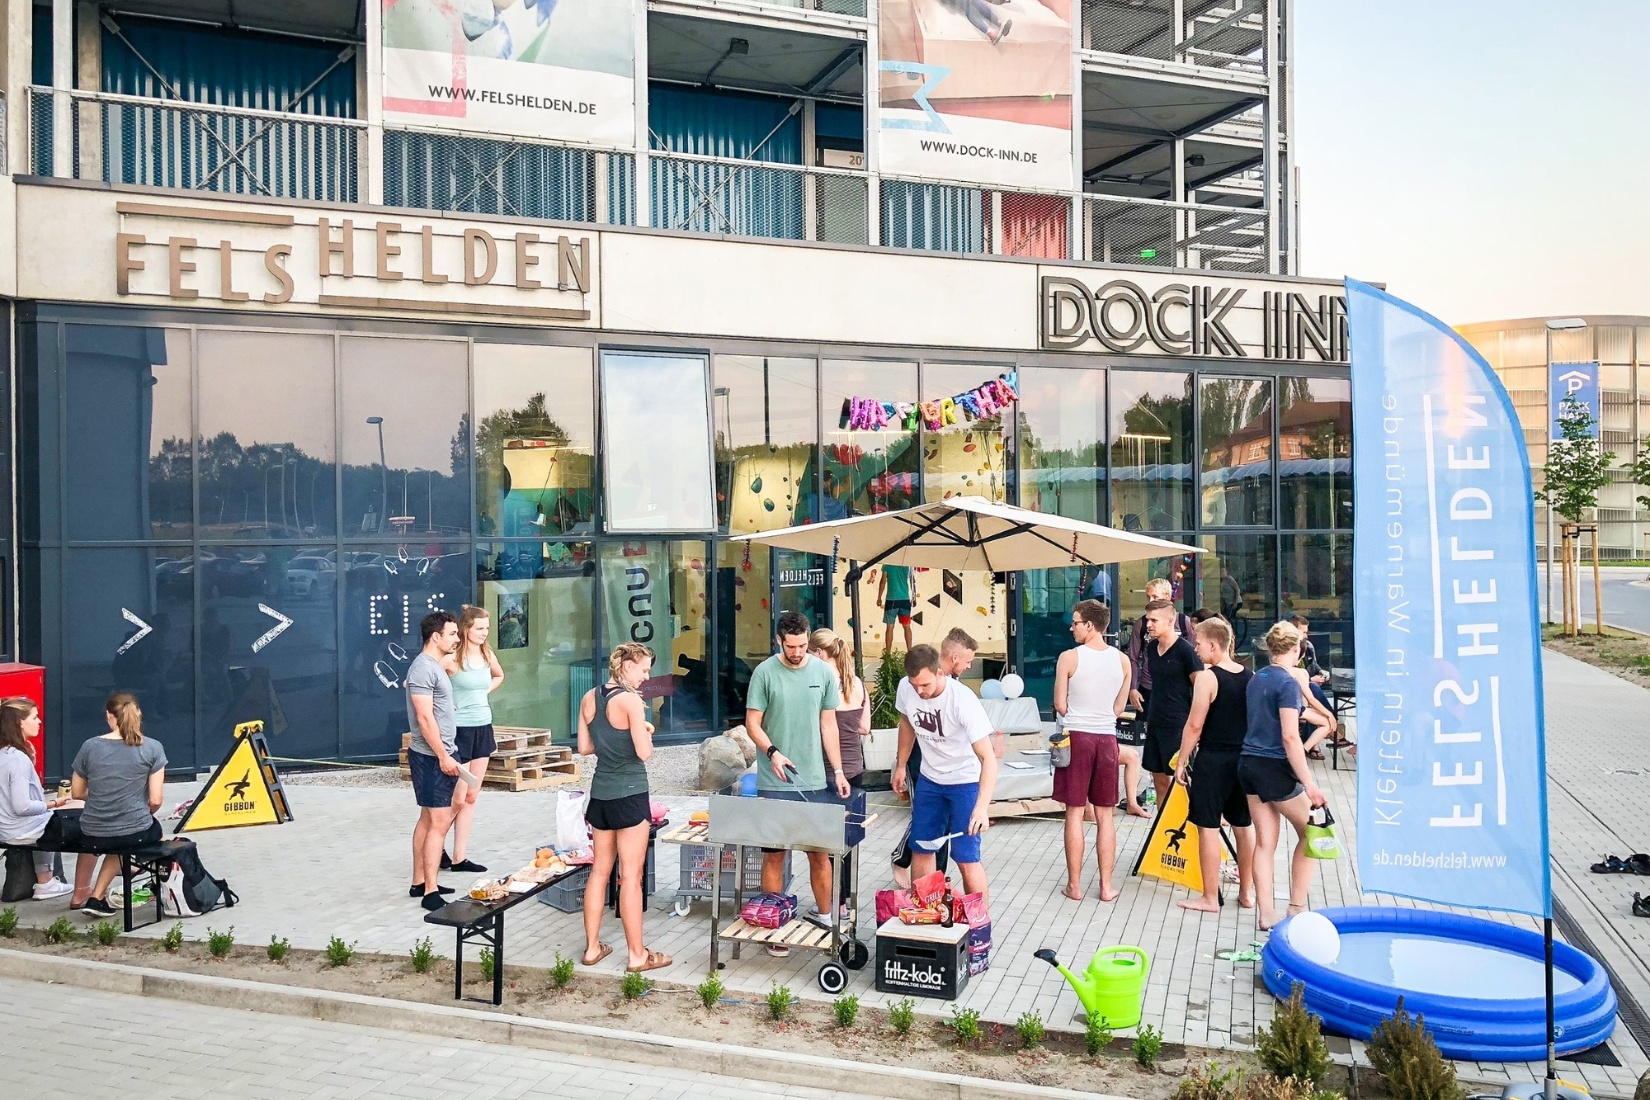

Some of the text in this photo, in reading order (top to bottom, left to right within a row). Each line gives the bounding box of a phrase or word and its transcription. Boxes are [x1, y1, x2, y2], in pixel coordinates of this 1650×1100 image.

[428, 84, 597, 115] WWW.FELSHELDEN.DE
[849, 155, 864, 166] 20
[920, 139, 1038, 164] WWW.DOCK-INN.DE
[1040, 275, 1248, 358] DOCK
[224, 801, 255, 812] GIBBON
[1161, 853, 1186, 869] GIBBON
